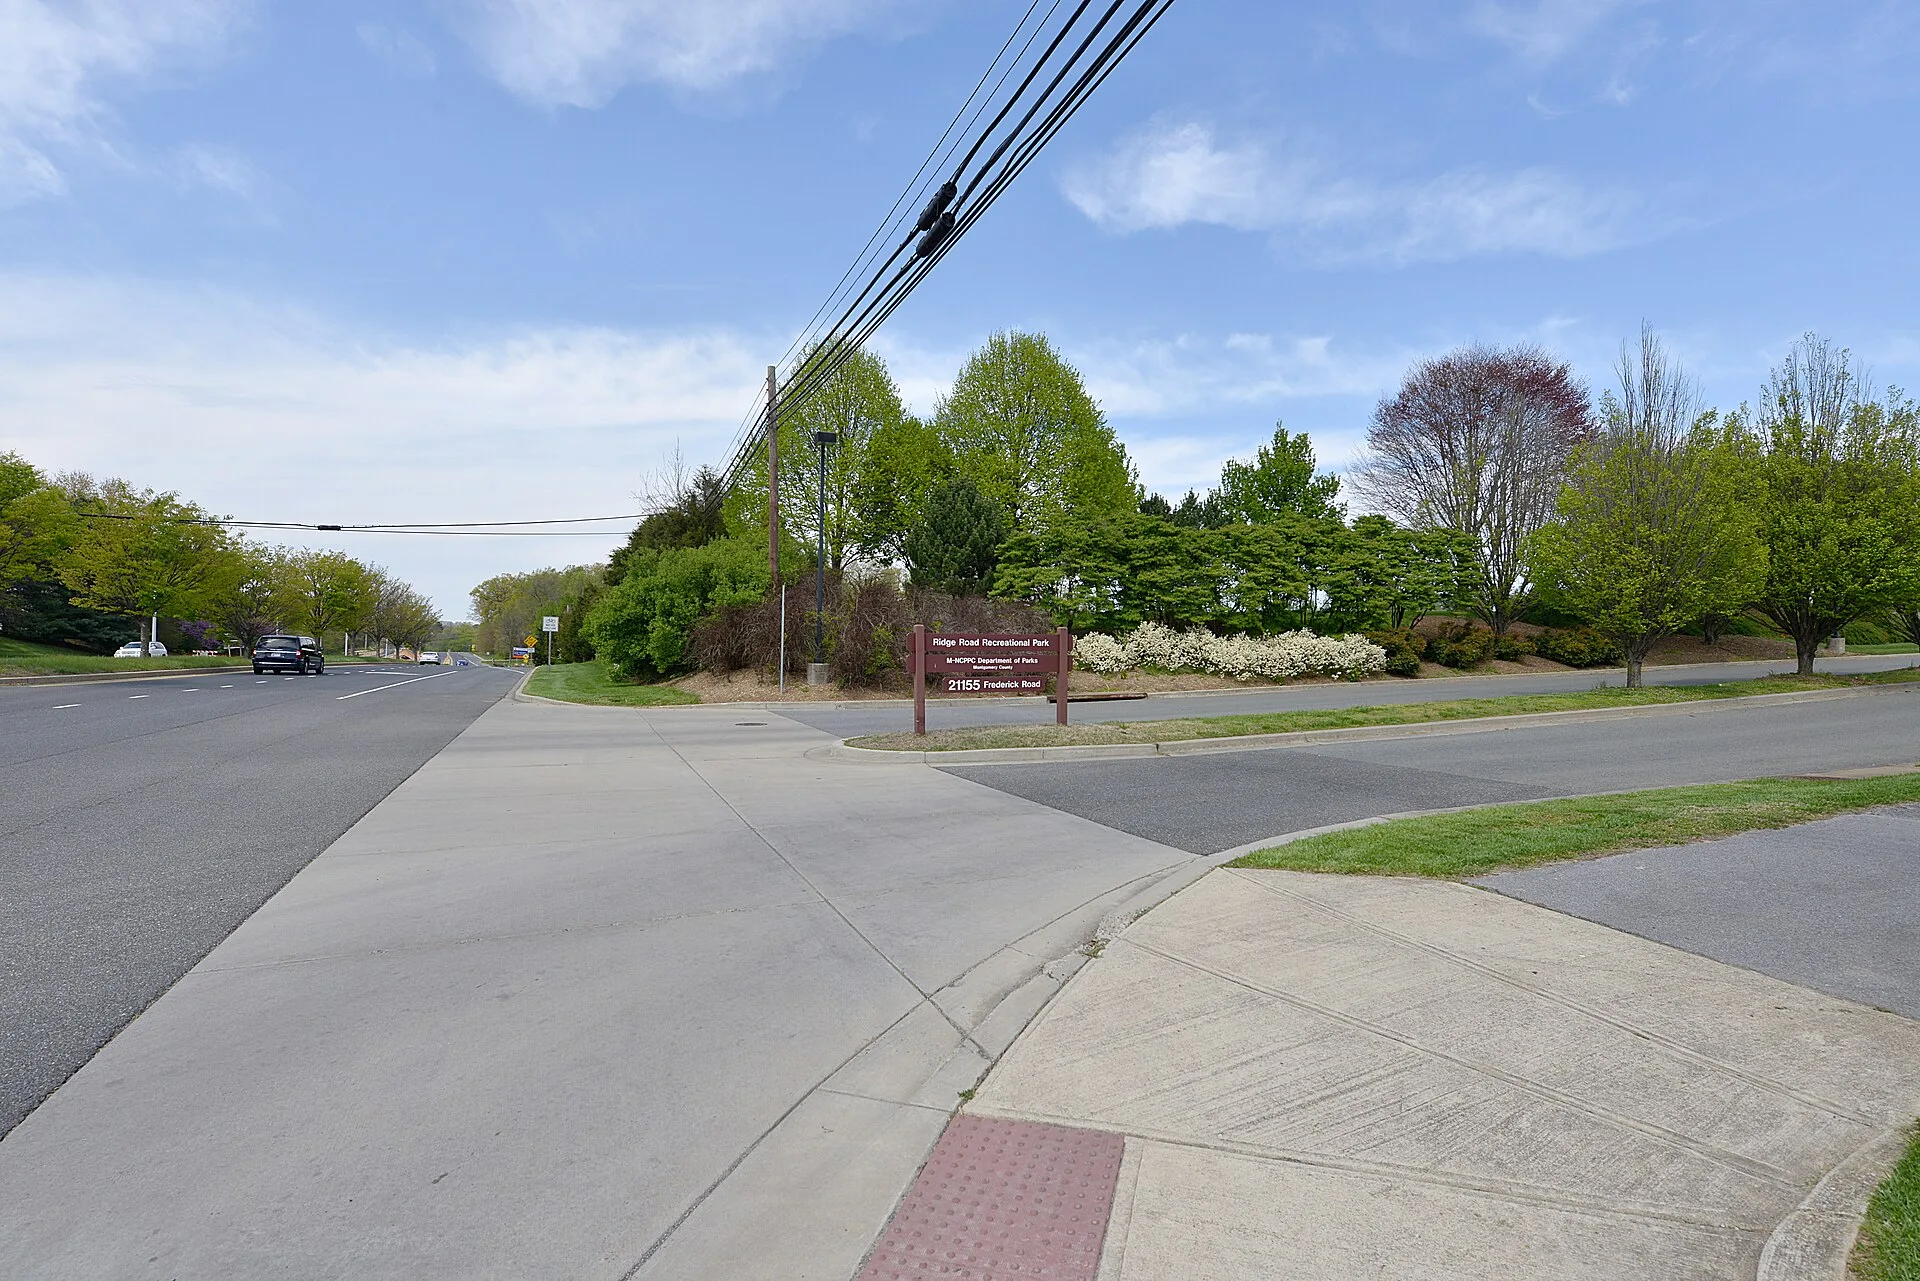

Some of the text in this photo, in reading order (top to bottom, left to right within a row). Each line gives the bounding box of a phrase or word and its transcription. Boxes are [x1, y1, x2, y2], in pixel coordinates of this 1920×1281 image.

[933, 638, 1049, 647] Ridge Road Recreational Park
[978, 657, 1012, 665] Department
[948, 679, 1041, 691] 21155 Frederick Road
